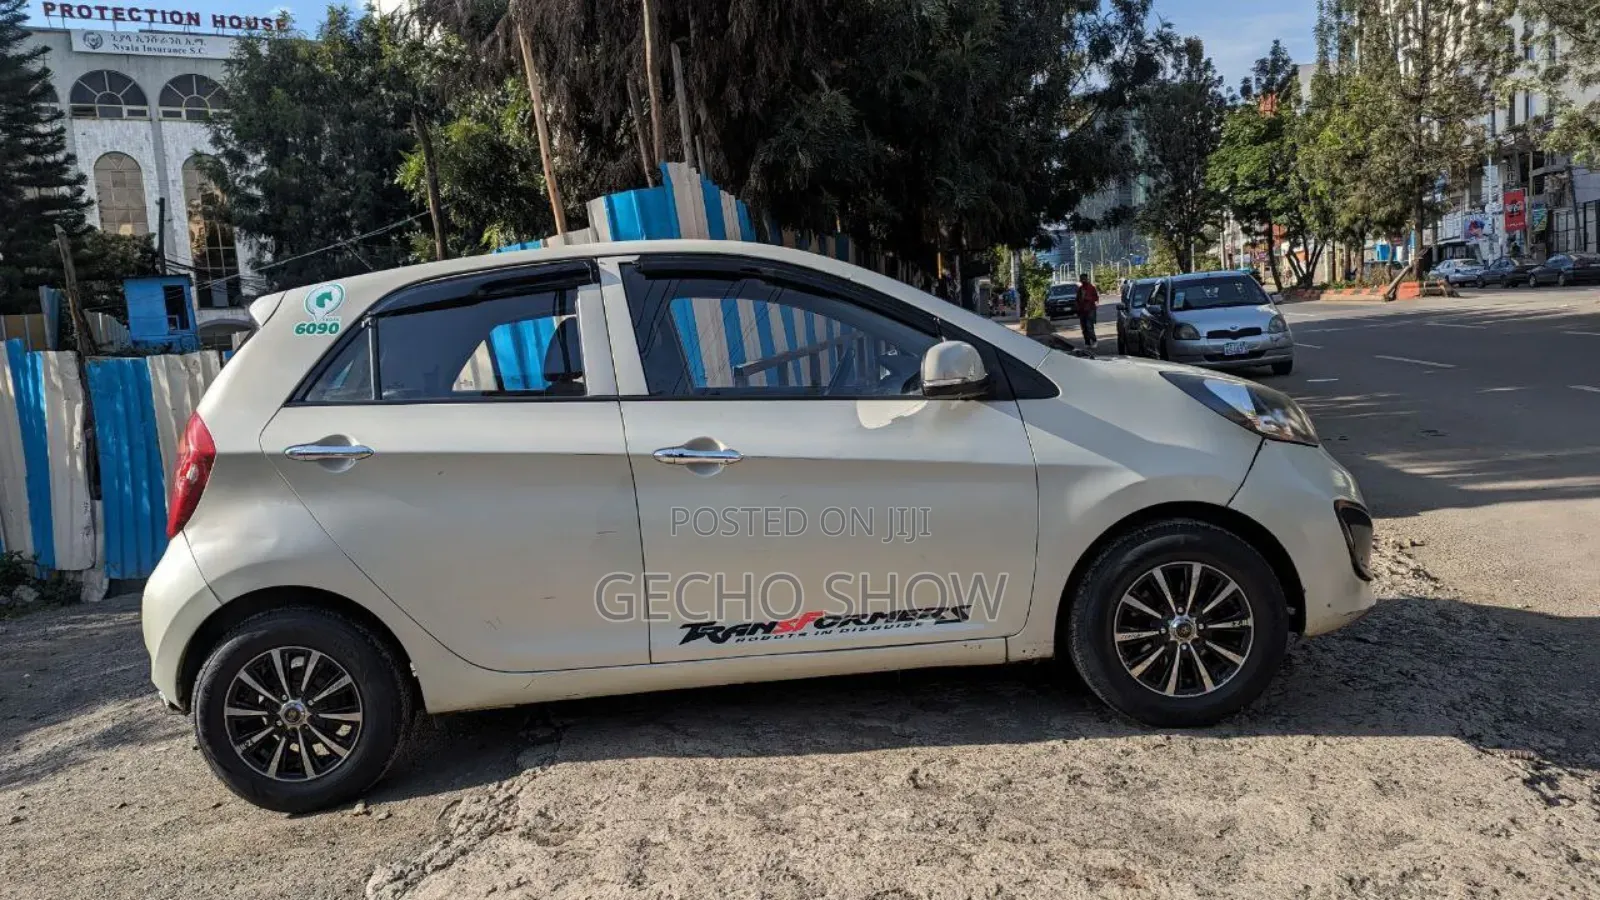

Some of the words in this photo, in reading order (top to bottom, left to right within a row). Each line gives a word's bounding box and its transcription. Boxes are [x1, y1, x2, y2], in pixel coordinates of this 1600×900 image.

[43, 1, 200, 26] PROTECTION
[212, 14, 286, 31] HOUSE
[113, 43, 140, 52] Nyala
[143, 45, 187, 54] Insurance
[295, 322, 340, 335] 6090
[679, 605, 972, 645] TRANSFORMERS
[734, 632, 806, 643] ROBOTS
[838, 621, 924, 633] DISGUISE
